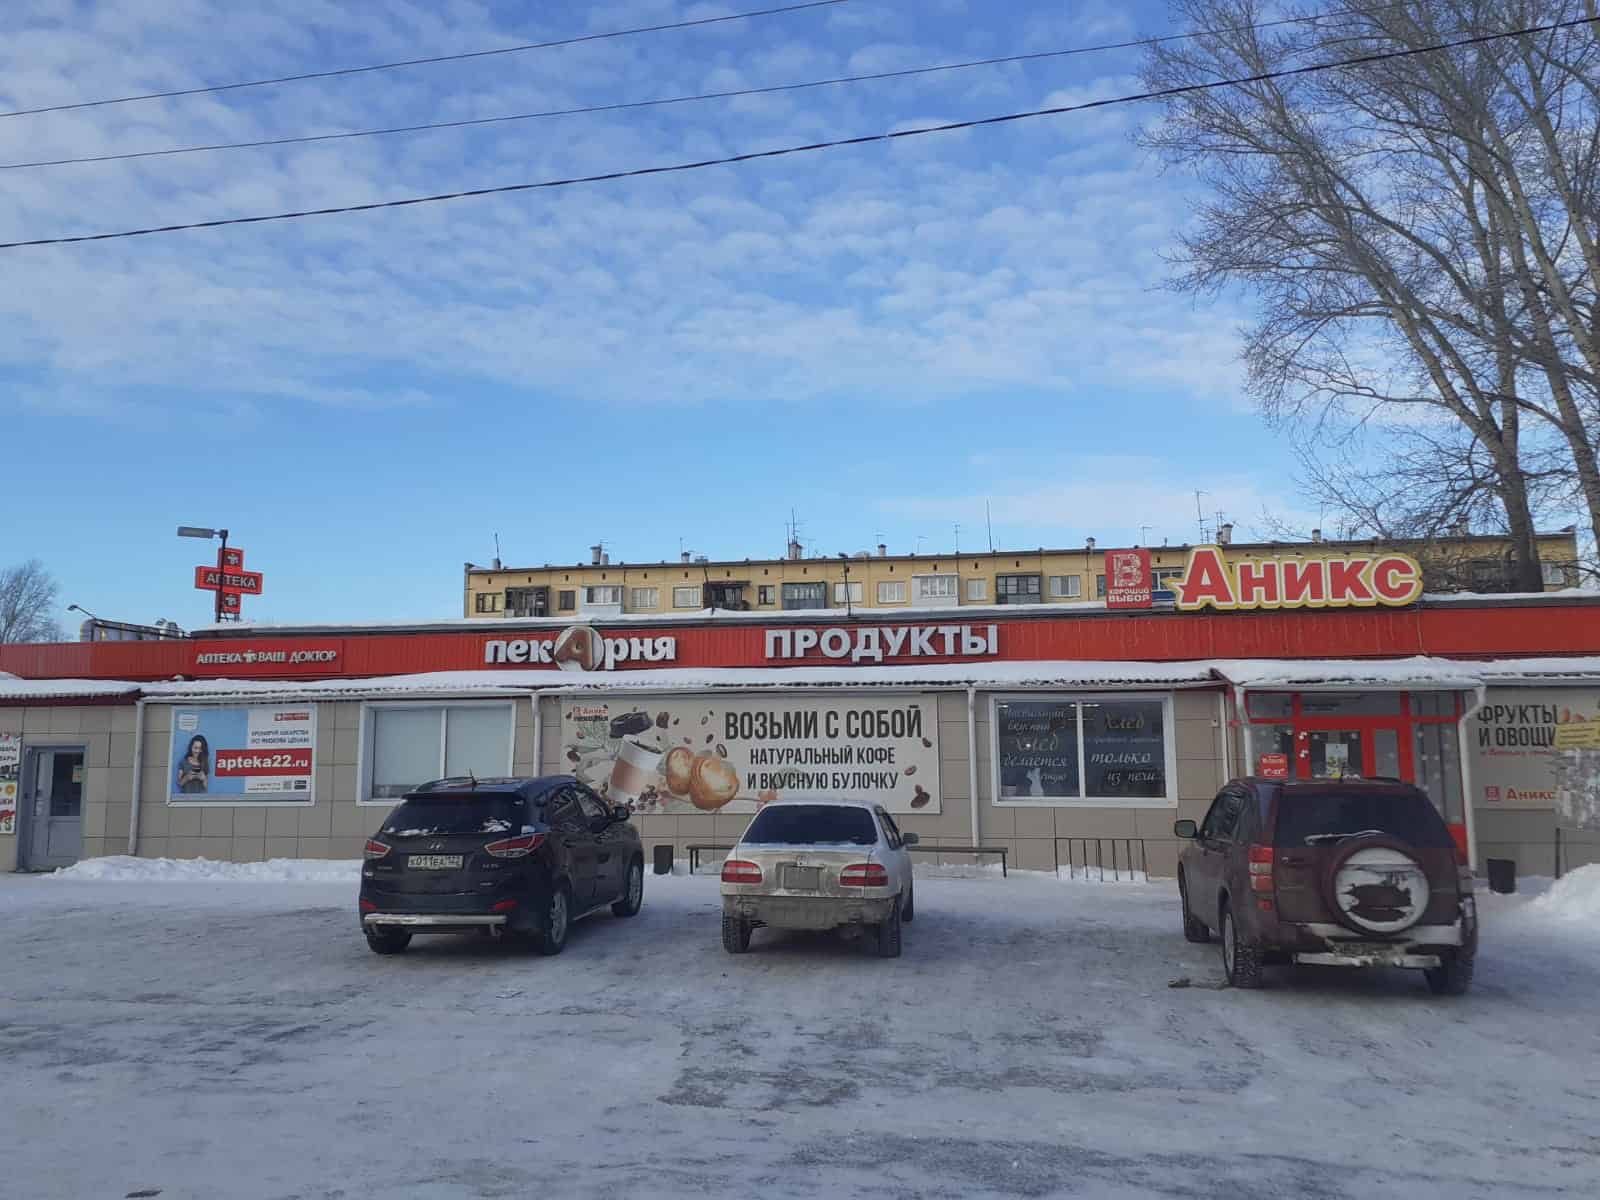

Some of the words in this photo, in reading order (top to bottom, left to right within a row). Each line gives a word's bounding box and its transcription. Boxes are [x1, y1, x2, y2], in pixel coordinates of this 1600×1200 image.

[1178, 549, 1418, 605] Аникс
[1108, 595, 1150, 603] ВЫБОР
[765, 626, 997, 663] ПРОДУКТЫ
[197, 652, 241, 664] АПТЕКА
[258, 651, 286, 662] ВАШ
[289, 650, 336, 664] ДОКТОР
[725, 711, 818, 740] ВОЗЬМИ
[825, 711, 838, 737] С
[846, 704, 922, 738] СОБОЙ
[1478, 704, 1559, 725] ФРУКТЫ
[1479, 727, 1490, 746] И
[216, 755, 309, 771] apteka22.ru
[750, 746, 852, 766] НАТУРАЛЬНЫЙ
[858, 747, 895, 765] КОФЕ
[747, 774, 757, 787] И
[761, 774, 828, 790] ВКУСНУЮ
[832, 772, 899, 790] БУЛОЧКУ
